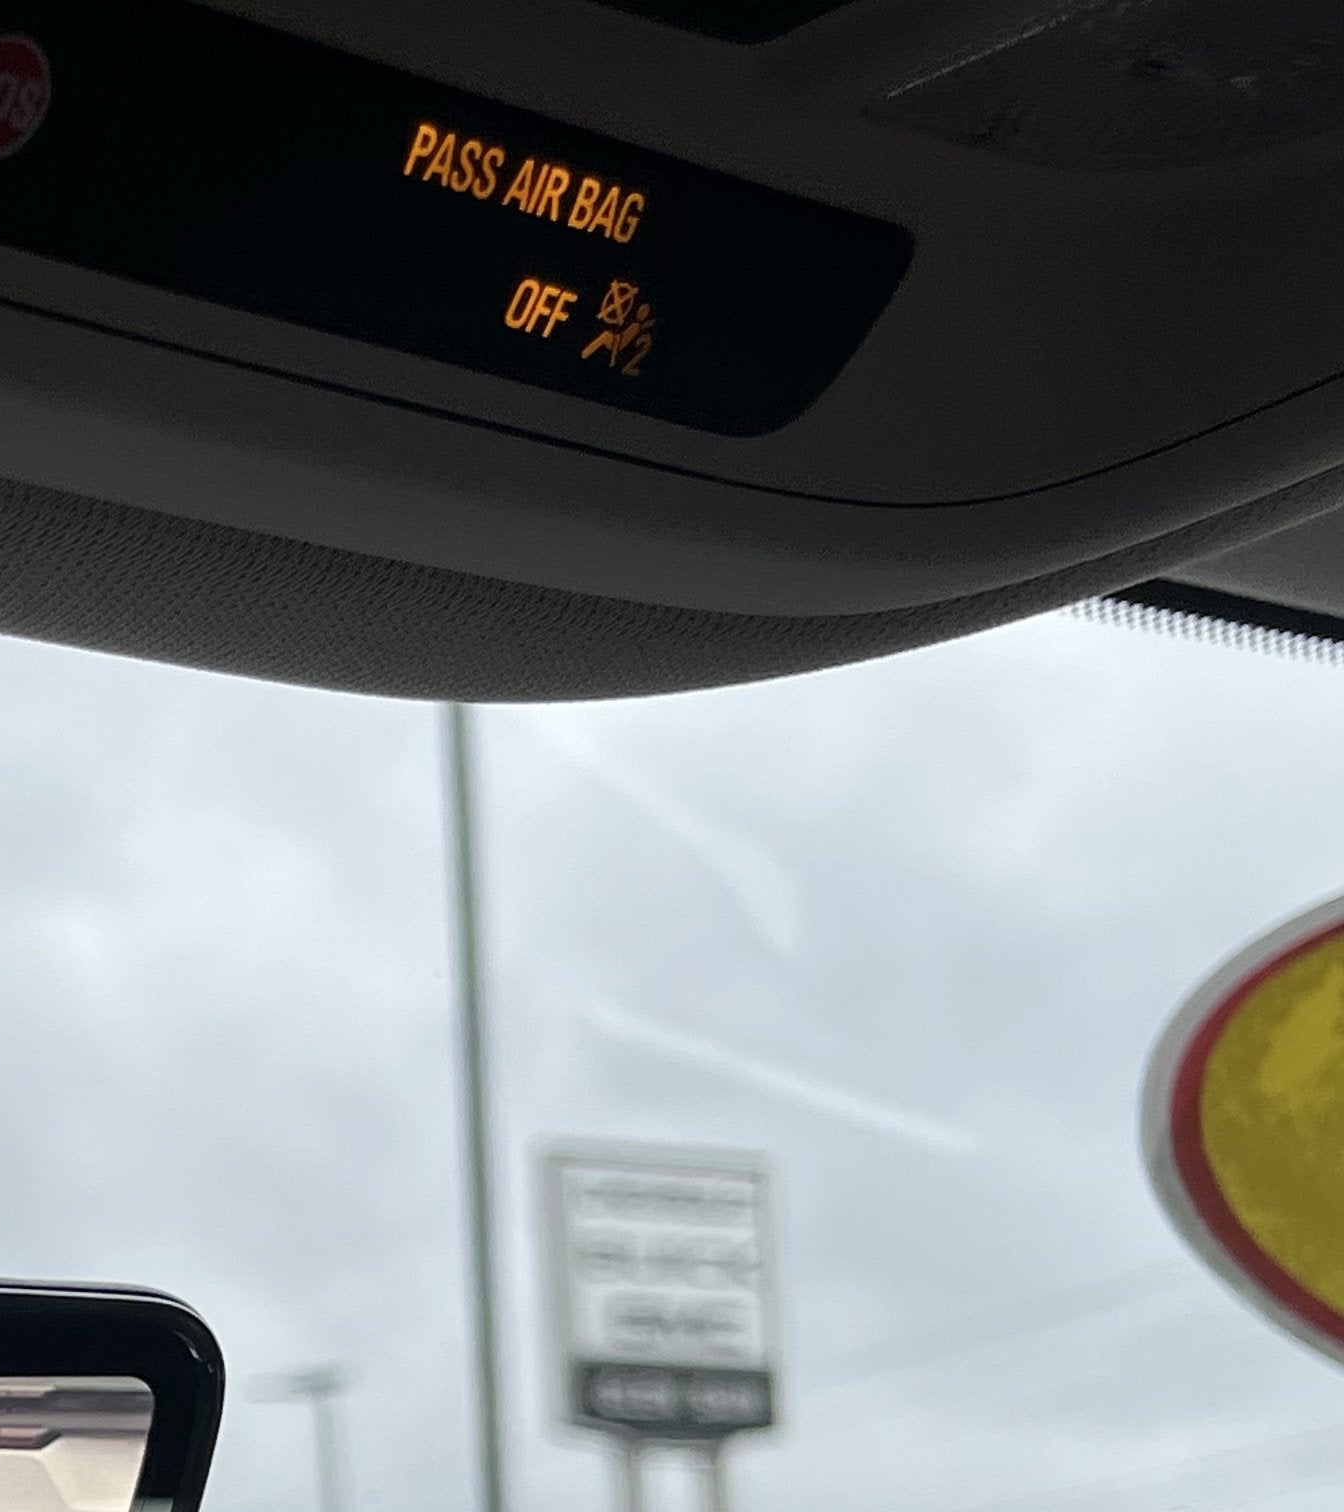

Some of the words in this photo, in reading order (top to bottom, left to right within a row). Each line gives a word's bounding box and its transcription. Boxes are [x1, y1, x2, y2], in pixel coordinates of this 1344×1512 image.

[403, 124, 506, 199] PASS
[501, 159, 570, 222] AIR
[566, 177, 645, 243] BAG
[504, 278, 579, 338] OFF
